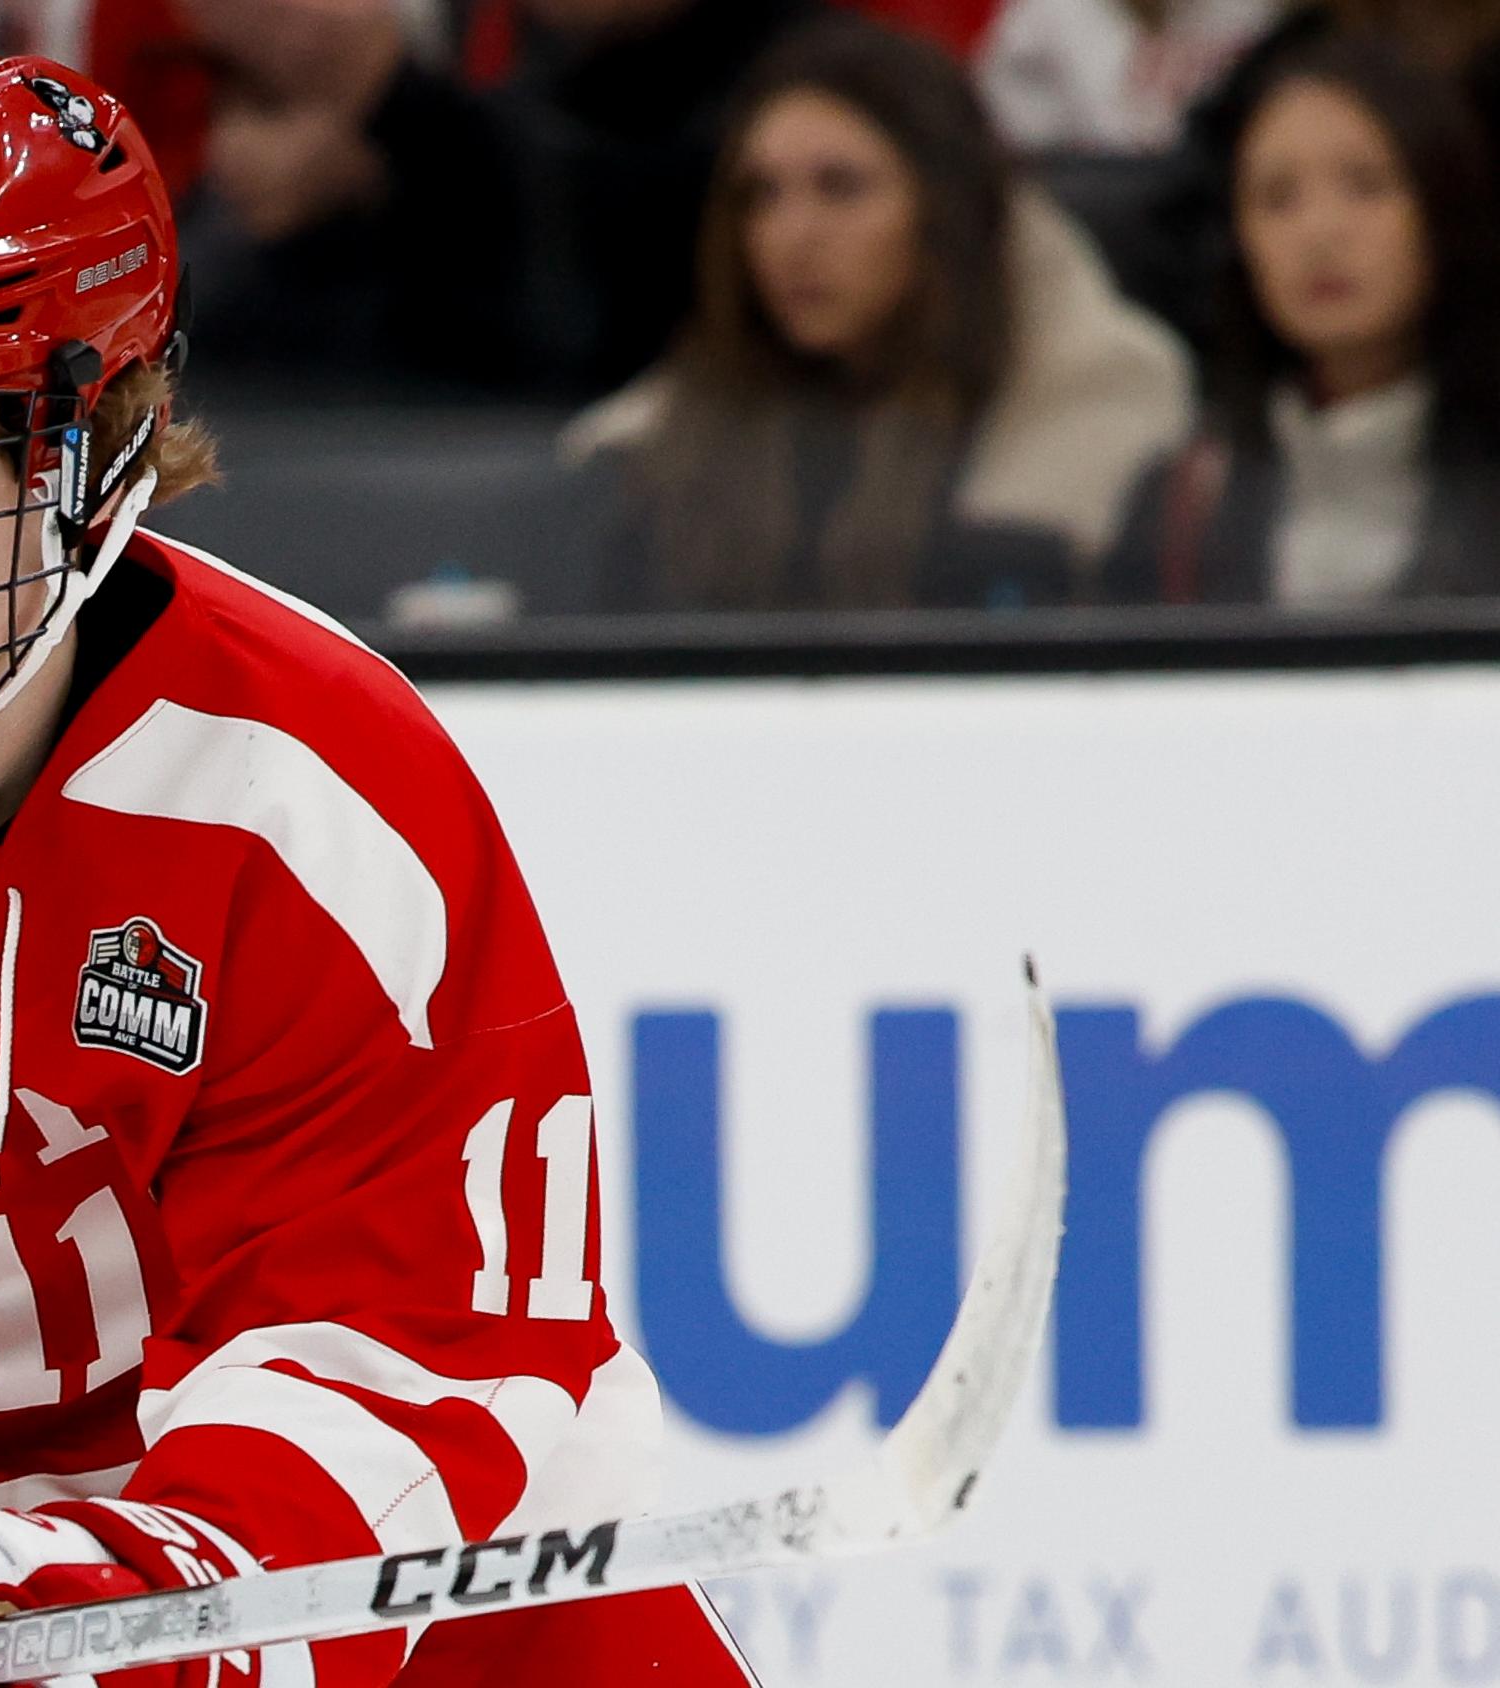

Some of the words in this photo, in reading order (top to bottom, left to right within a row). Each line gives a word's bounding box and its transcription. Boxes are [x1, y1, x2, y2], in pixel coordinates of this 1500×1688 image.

[75, 243, 148, 294] BAUER
[112, 962, 161, 987] BATTLE
[79, 978, 192, 1055] COMM
[114, 1031, 137, 1046] AVE
[461, 1094, 594, 1321] 11
[370, 1519, 621, 1618] CCM
[936, 1567, 1158, 1677] TAX
